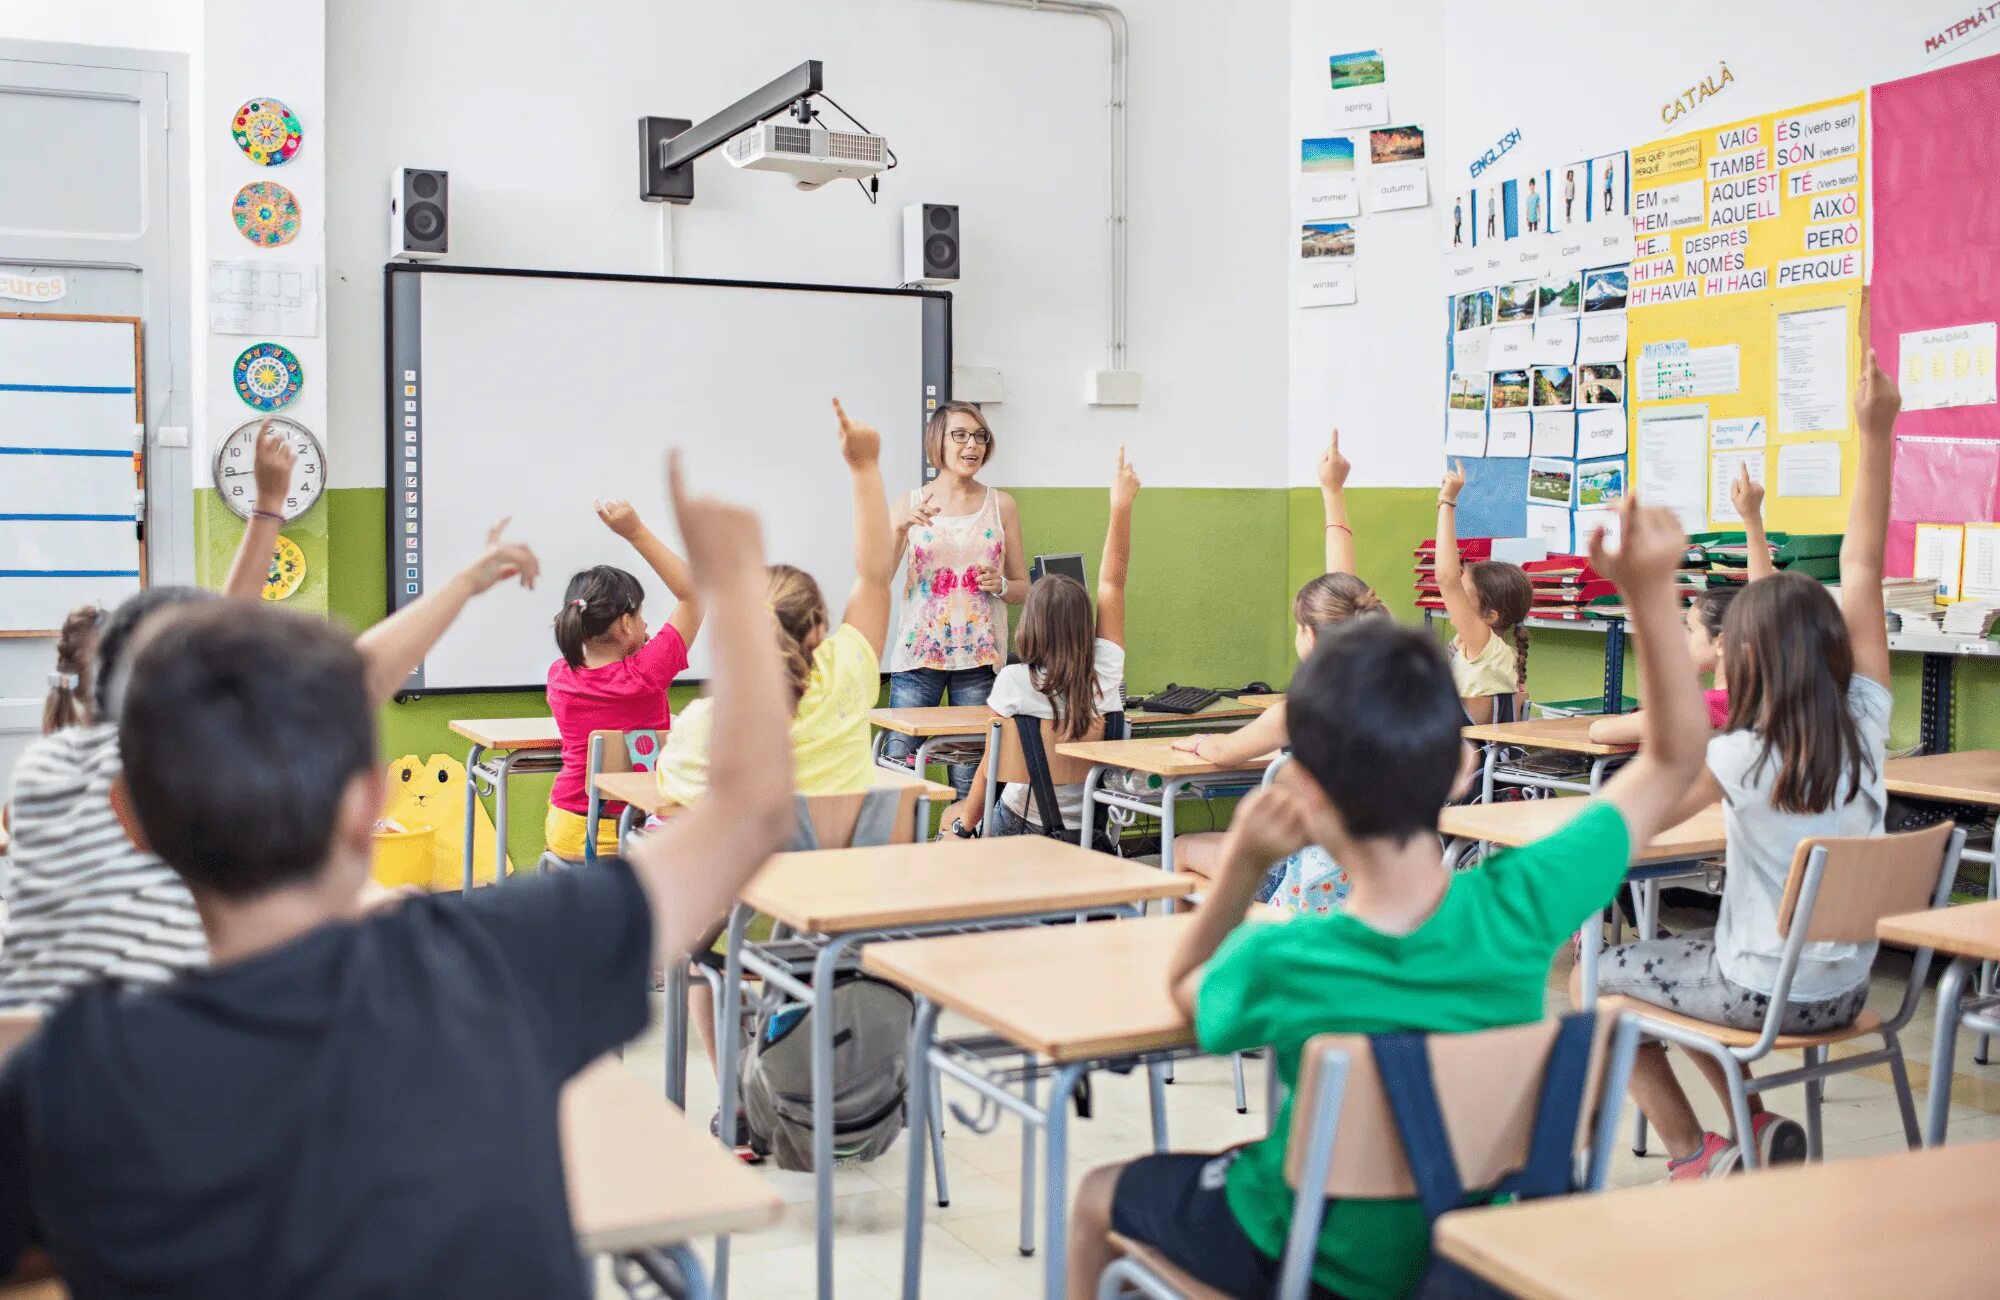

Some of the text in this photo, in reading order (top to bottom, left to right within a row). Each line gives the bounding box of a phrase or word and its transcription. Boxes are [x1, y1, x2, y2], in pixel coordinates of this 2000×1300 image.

[1661, 60, 1734, 124] CATALÀ
[1344, 102, 1372, 113] spring
[1777, 113, 1856, 141] ÉS (verb ser)
[1719, 127, 1758, 150] VAIG
[1469, 127, 1522, 179] ENGLISH
[1777, 142, 1855, 166] SÓN (verb ser)
[1710, 149, 1766, 179] TAMBÉ
[1381, 184, 1414, 194] autumn
[1711, 173, 1778, 203] AQUEST
[1791, 171, 1813, 194] TÉ
[1312, 194, 1347, 203] summer
[1636, 191, 1658, 210] EM
[1813, 193, 1856, 219] AIXÒ
[1635, 212, 1668, 232] HEM
[1711, 200, 1776, 227] AQUELL
[1603, 236, 1619, 247] Ellie
[1685, 229, 1748, 255] DESPRÉS
[1807, 223, 1858, 250] PERÒ
[1636, 238, 1669, 257] HE...
[1520, 252, 1539, 263] Oliver
[1687, 252, 1745, 276] NOMÉS
[1634, 260, 1674, 280] HI HA
[1779, 254, 1854, 283] PERQUÈ
[1312, 280, 1339, 289] winter
[1707, 271, 1767, 294] HI HAGI
[1631, 281, 1697, 304] HI HAVIA
[1504, 344, 1518, 352] lake
[1586, 333, 1620, 345] mountain
[244, 432, 252, 443] 11
[1502, 430, 1517, 440] gate
[1590, 427, 1615, 440] bridge
[230, 447, 241, 457] 10
[298, 444, 308, 454] 2
[224, 466, 236, 477] 9
[304, 463, 315, 474] 3
[232, 486, 244, 496] 8
[300, 482, 310, 492] 4
[287, 497, 298, 508] 5
[1541, 523, 1557, 534] farm
